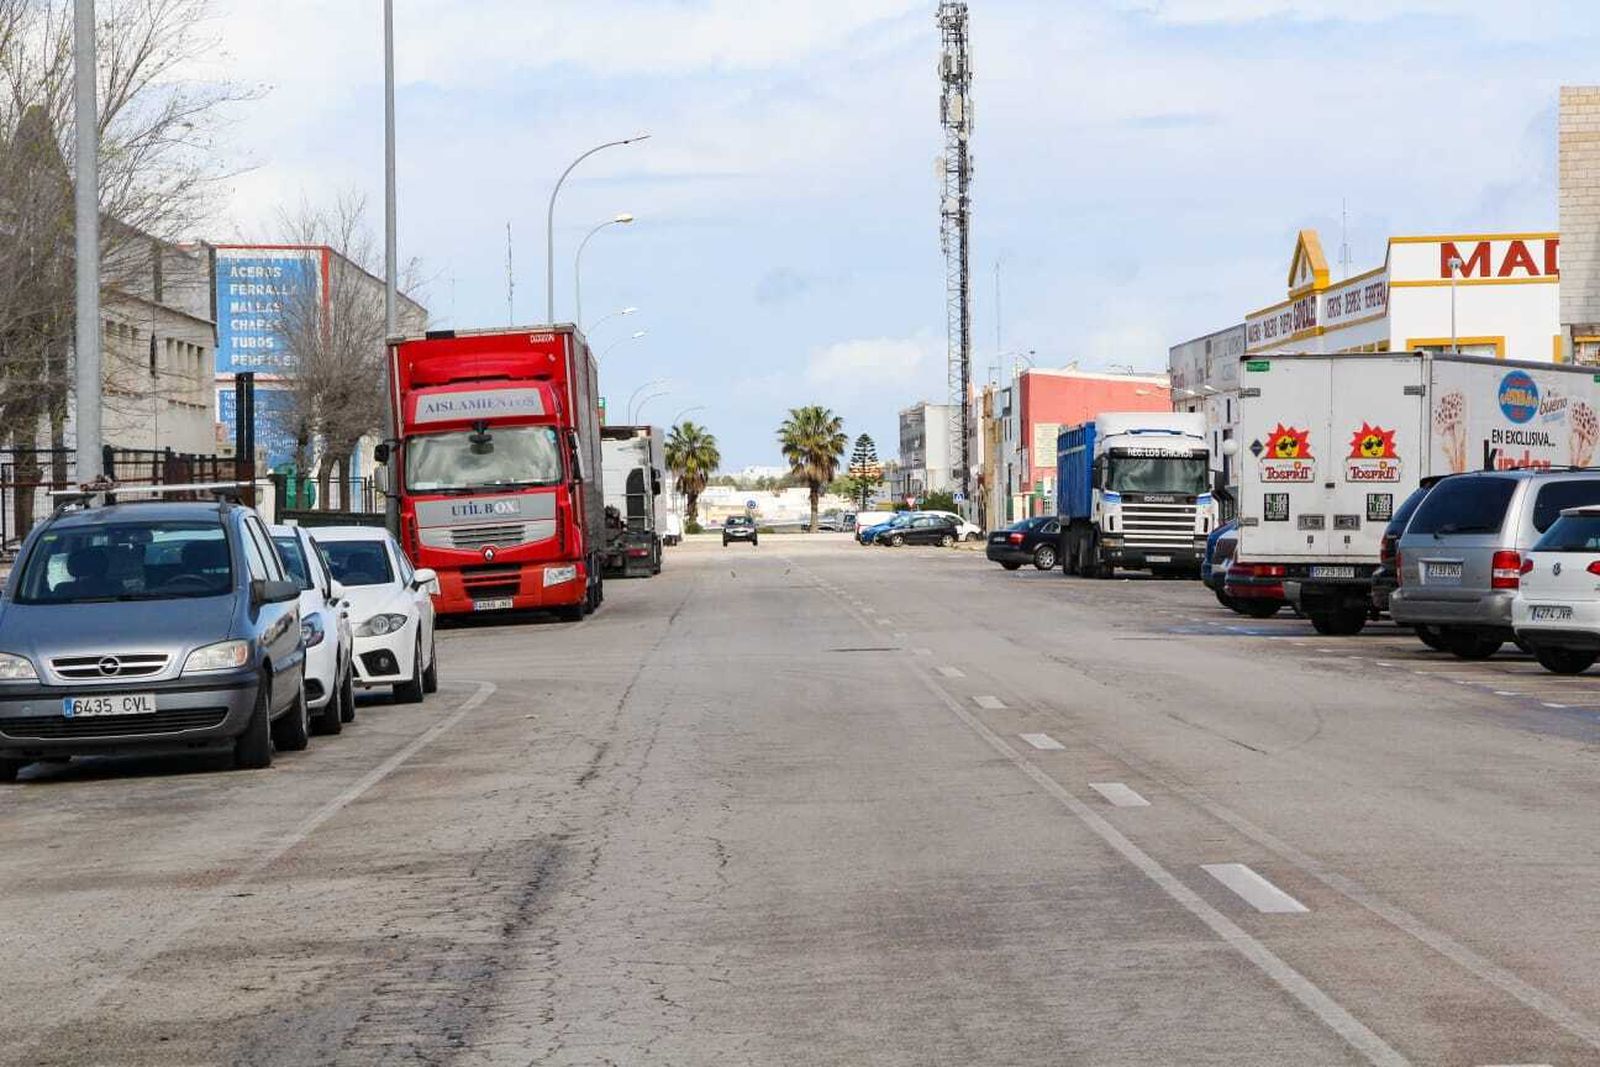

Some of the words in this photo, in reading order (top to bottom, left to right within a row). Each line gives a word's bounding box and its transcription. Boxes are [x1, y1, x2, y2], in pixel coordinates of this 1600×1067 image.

[230, 266, 282, 278] ACEROS
[231, 337, 274, 348] TUBOS
[424, 396, 536, 414] AISLAMIENTOS
[1492, 429, 1503, 443] EN
[73, 699, 113, 714] 6435
[122, 696, 152, 712] CVL
